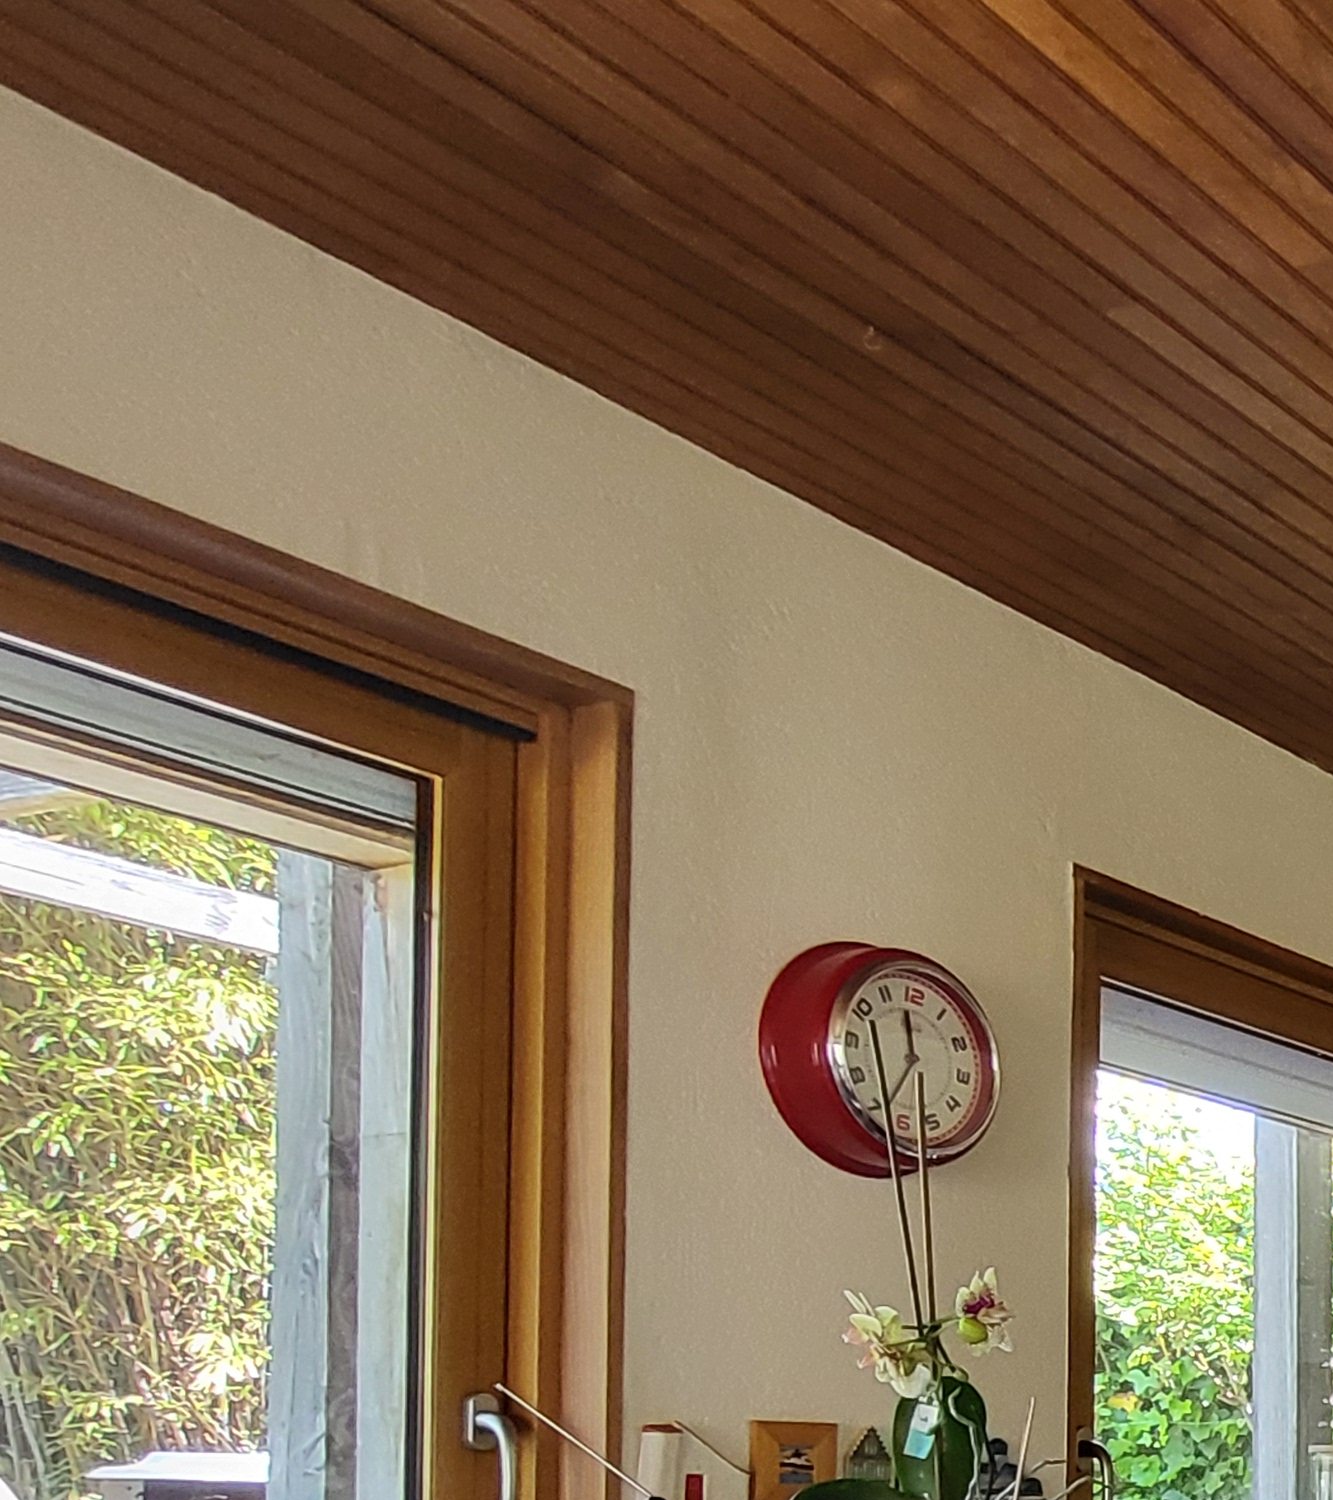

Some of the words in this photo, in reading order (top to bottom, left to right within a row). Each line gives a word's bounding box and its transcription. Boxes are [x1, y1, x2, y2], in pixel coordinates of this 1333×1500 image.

[878, 985, 893, 1004] 11
[904, 986, 926, 1007] 12
[851, 997, 873, 1022] 10
[936, 1008, 947, 1021] 1
[844, 1030, 860, 1049] 9
[951, 1036, 968, 1053] 2
[849, 1066, 866, 1084] 8
[956, 1068, 971, 1085] 3
[867, 1097, 882, 1113] 7
[945, 1095, 962, 1112] 4
[896, 1114, 910, 1131] 6
[924, 1113, 941, 1132] 5
